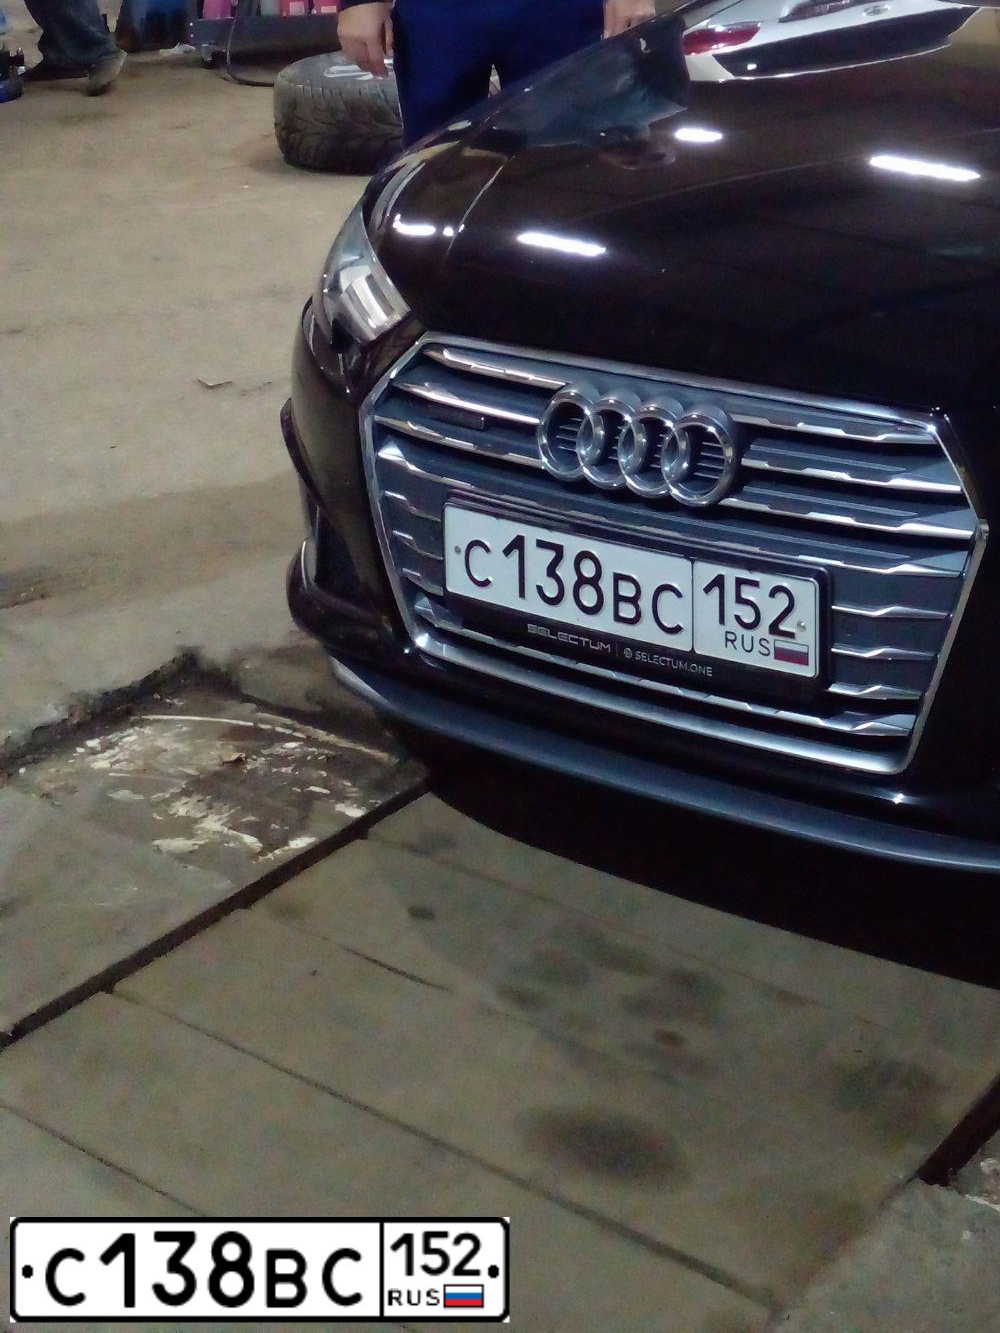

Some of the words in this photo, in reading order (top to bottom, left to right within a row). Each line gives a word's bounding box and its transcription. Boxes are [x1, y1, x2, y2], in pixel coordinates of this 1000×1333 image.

[464, 534, 684, 635] С138ВС
[702, 573, 798, 639] 152
[527, 623, 611, 654] SELECTUM
[725, 630, 771, 657] RUS
